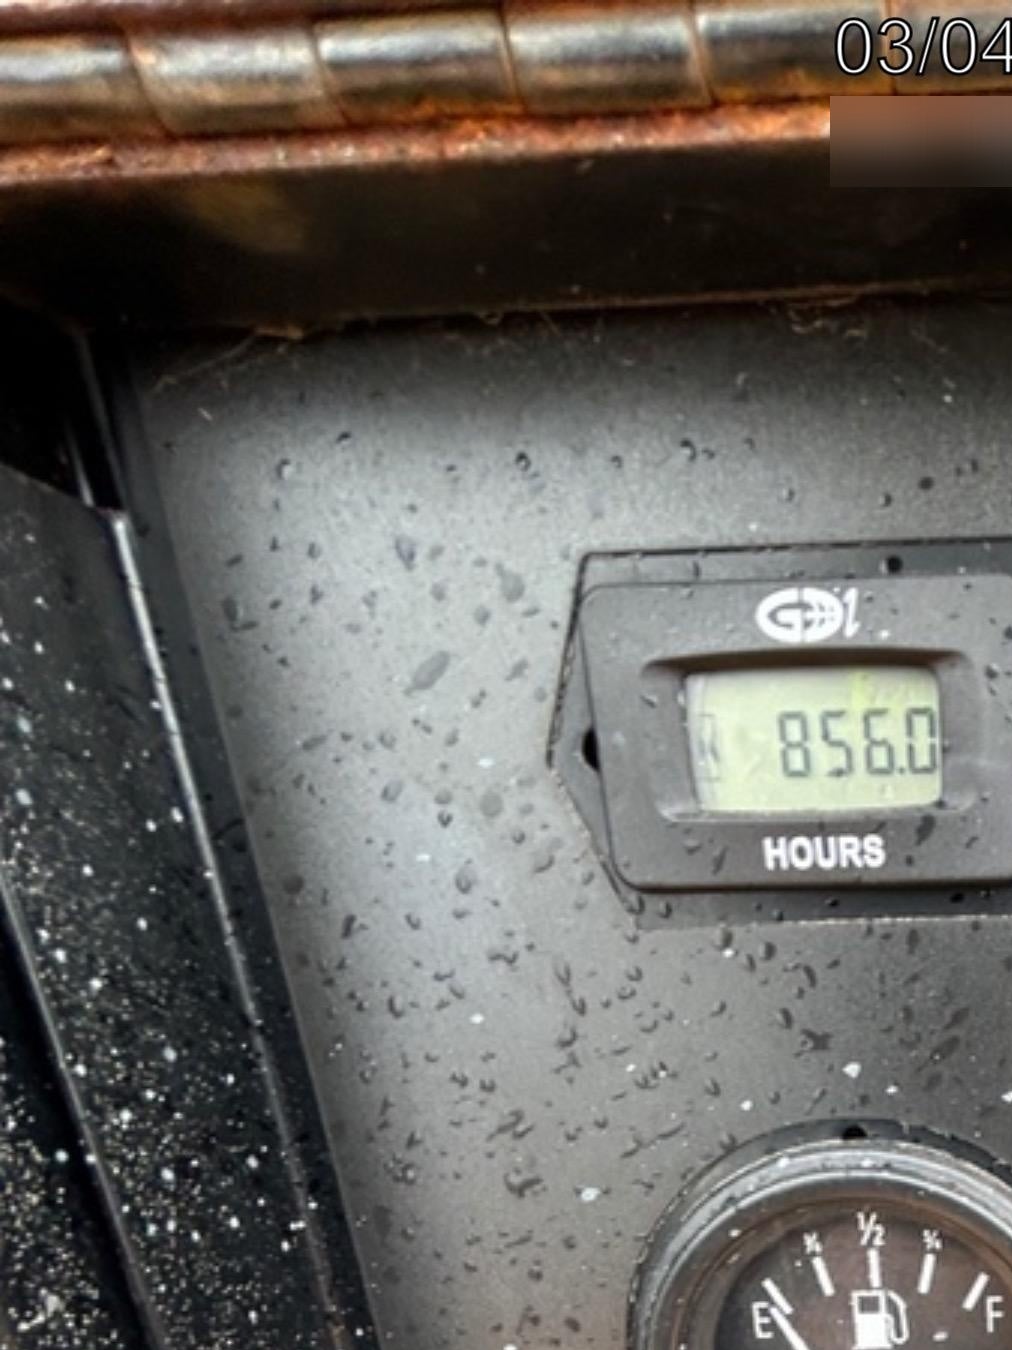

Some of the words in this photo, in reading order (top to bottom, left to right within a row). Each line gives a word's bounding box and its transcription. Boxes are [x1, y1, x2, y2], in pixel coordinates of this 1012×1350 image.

[777, 707, 938, 778] 856.0
[762, 836, 887, 870] HOURS
[752, 1302, 774, 1338] E
[986, 1296, 1005, 1333] F
